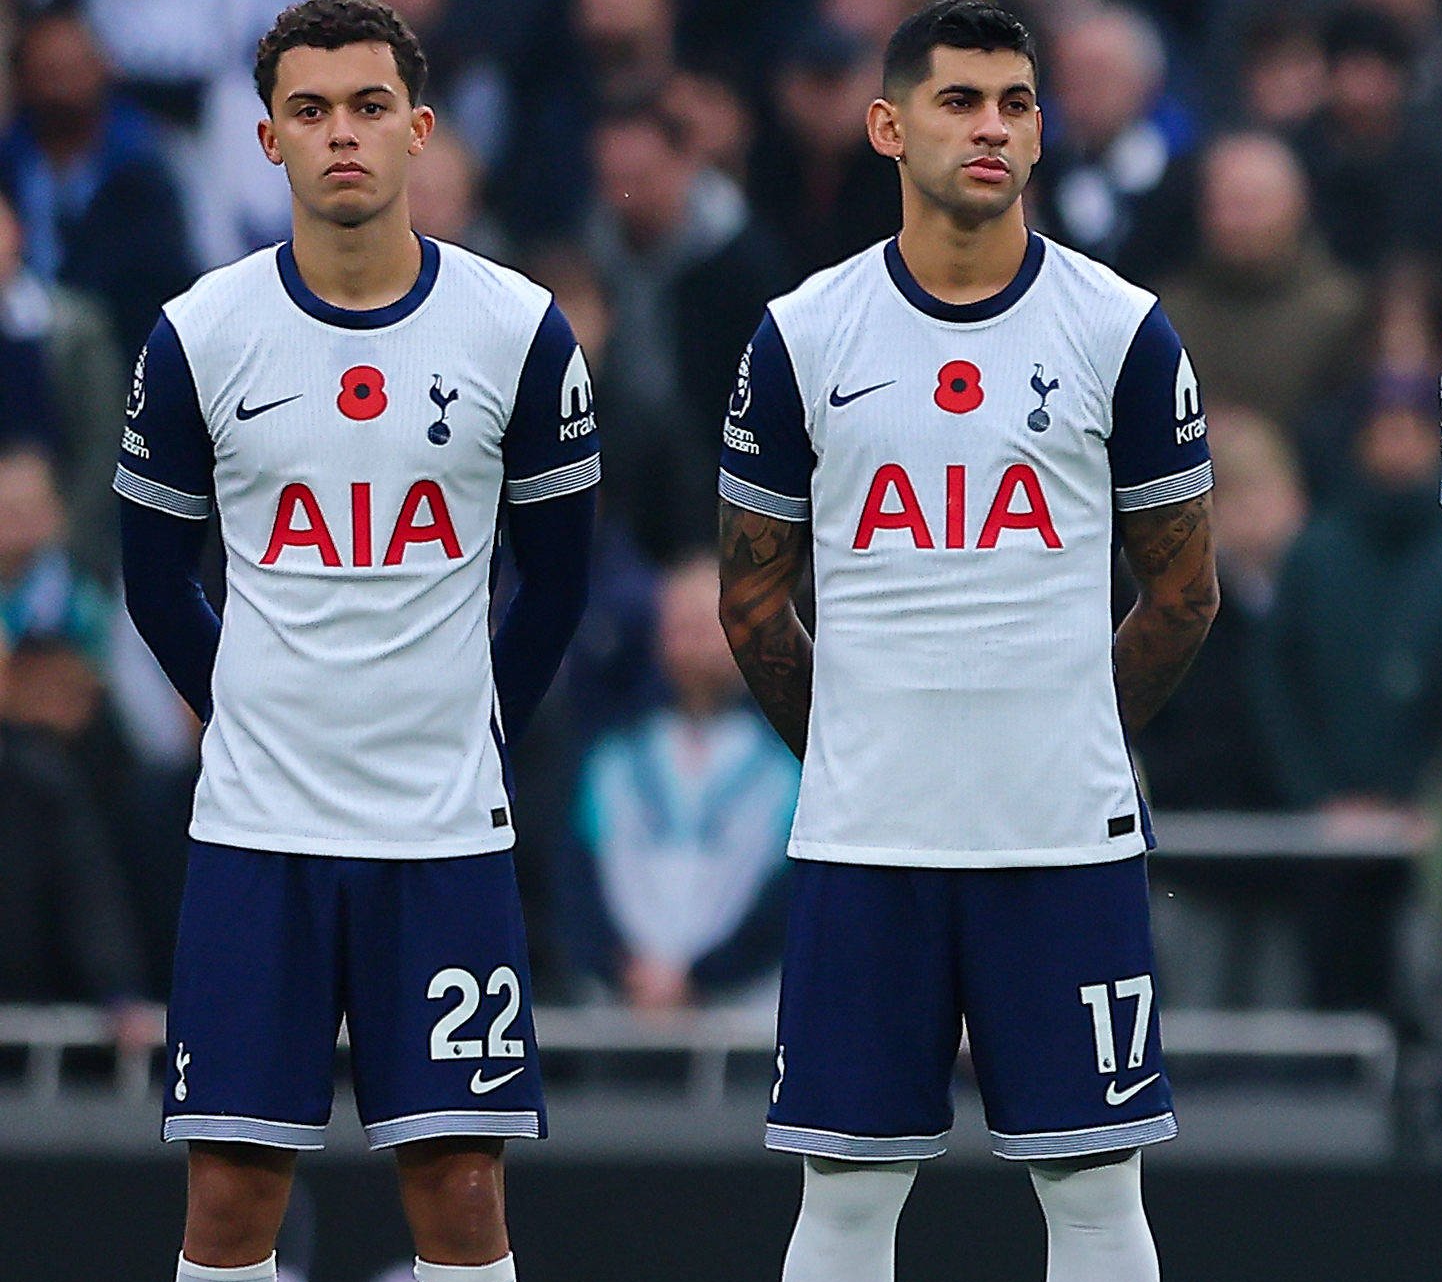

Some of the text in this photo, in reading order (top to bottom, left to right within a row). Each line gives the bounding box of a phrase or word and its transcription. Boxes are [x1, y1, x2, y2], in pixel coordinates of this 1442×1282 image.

[261, 482, 462, 566] AIA
[855, 464, 1061, 549] AIA
[428, 967, 524, 1059] 22
[1081, 975, 1152, 1073] 17
